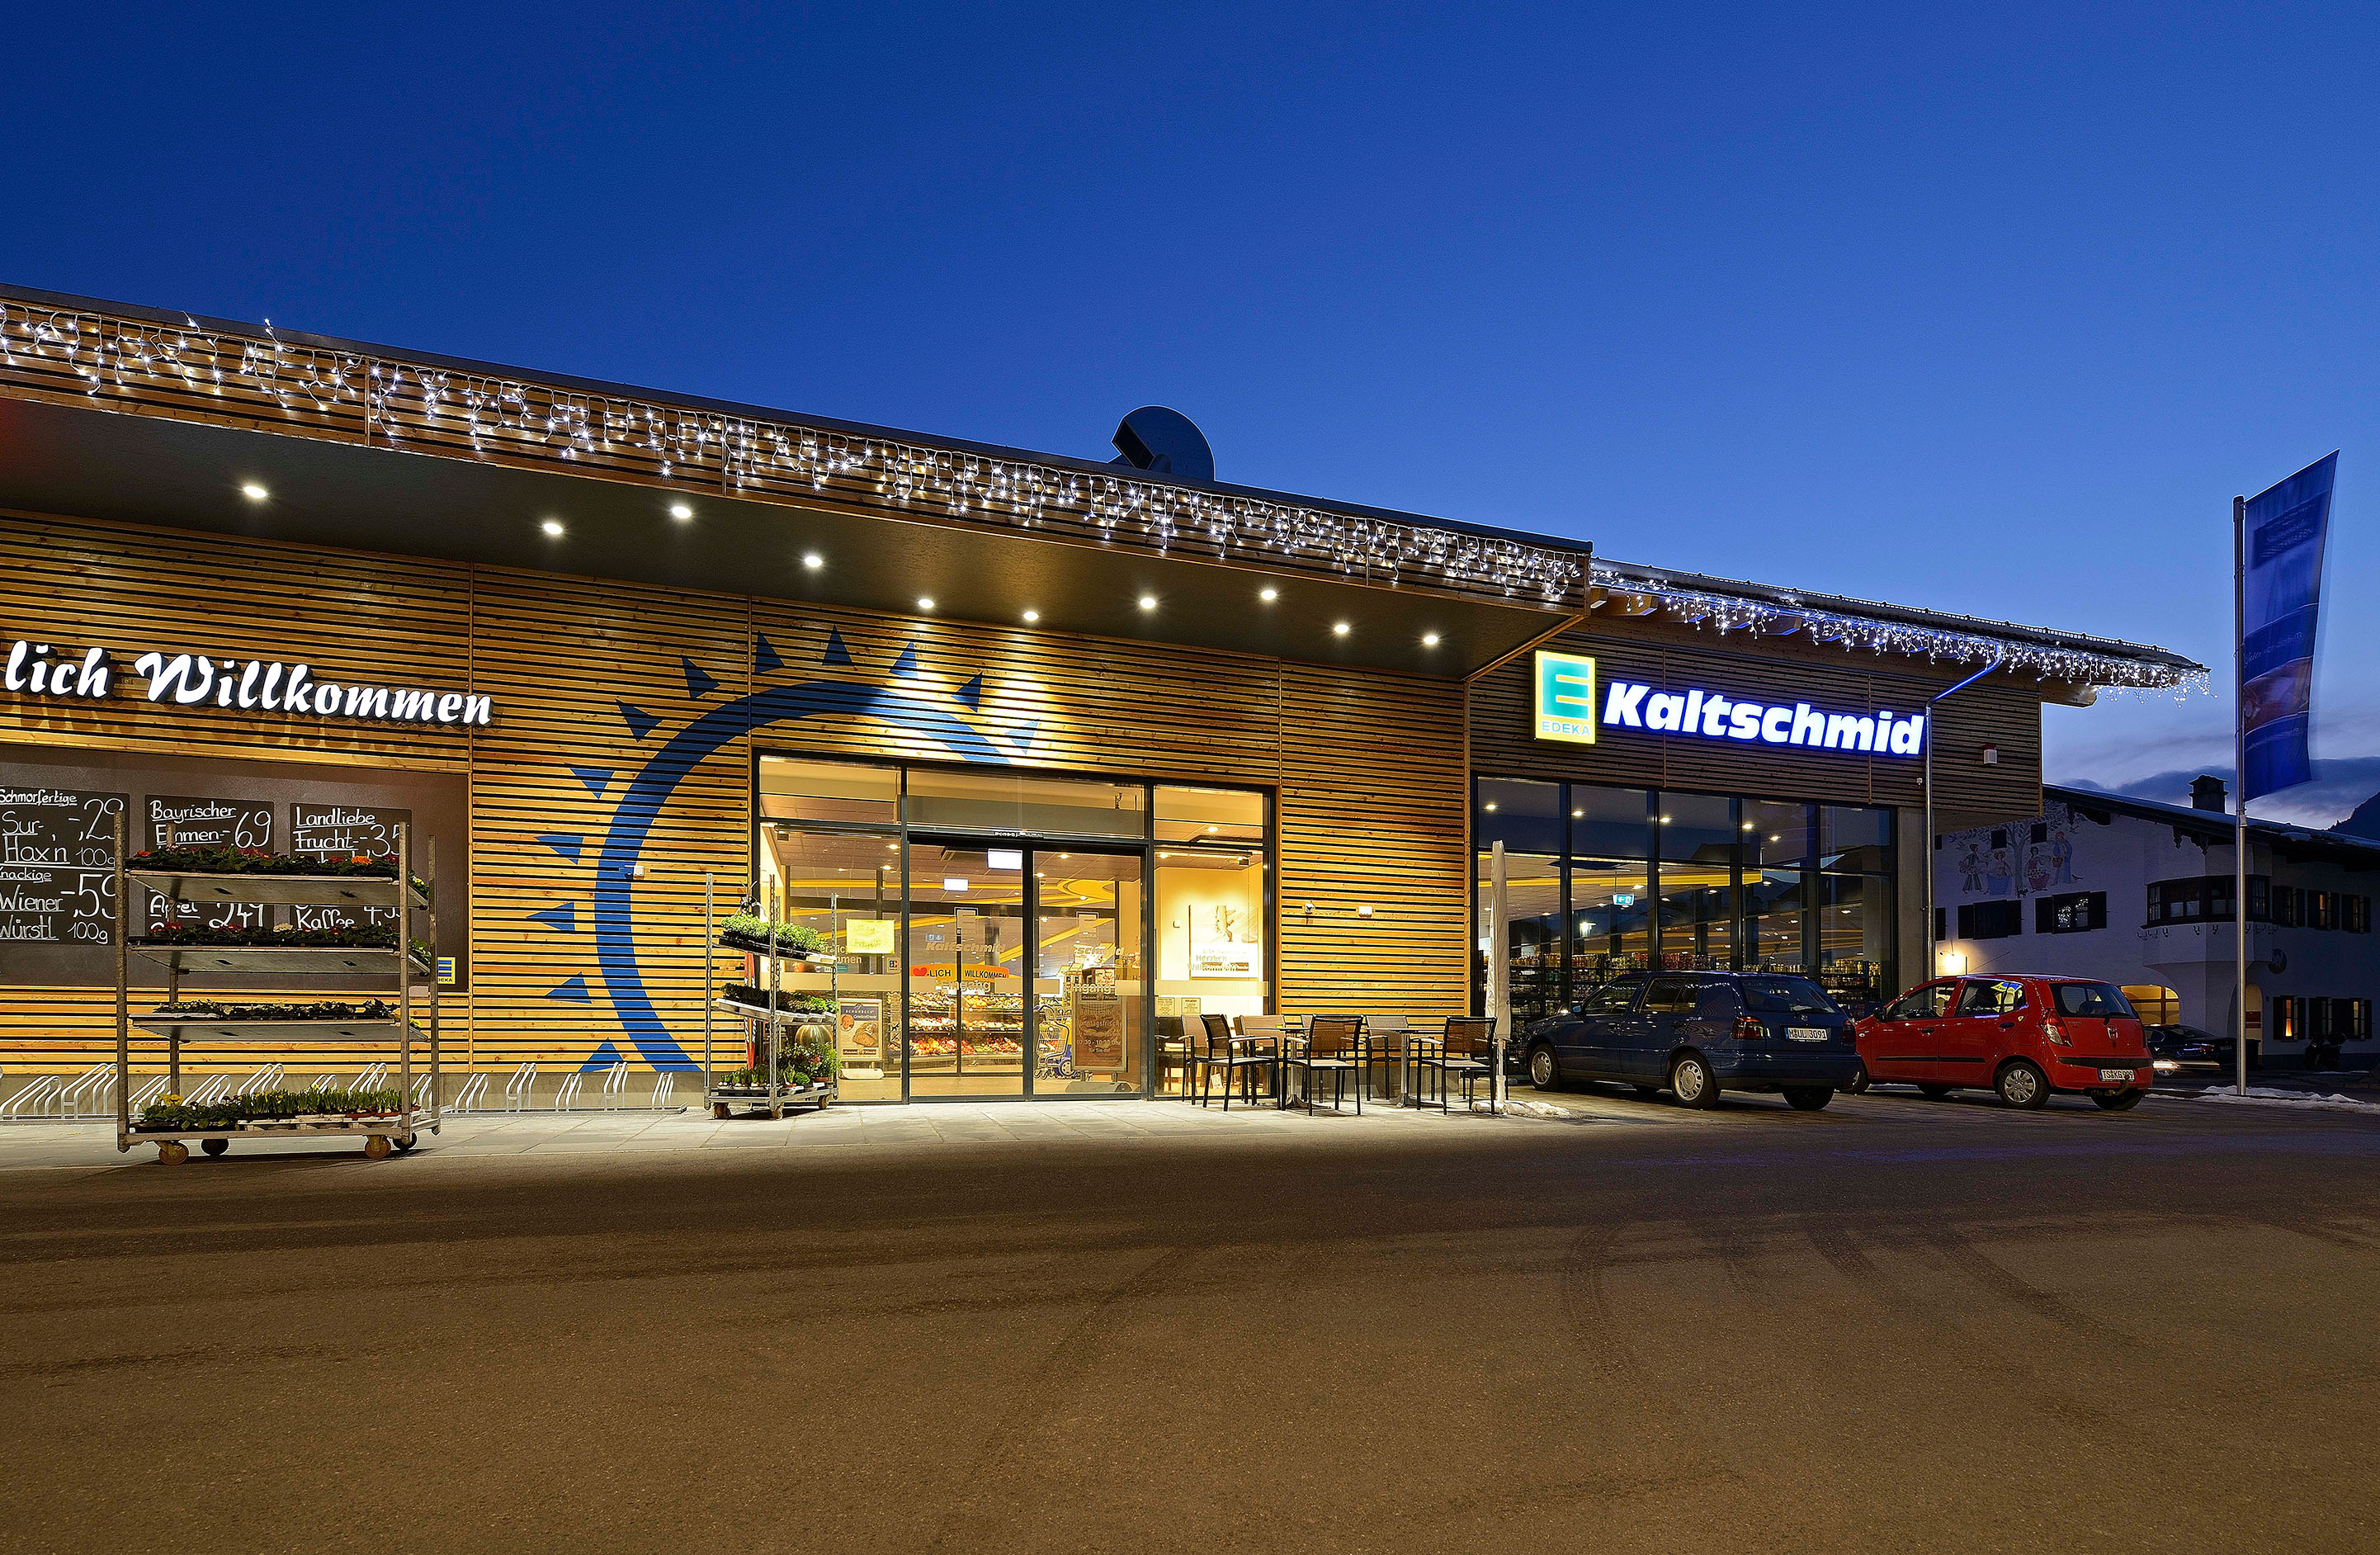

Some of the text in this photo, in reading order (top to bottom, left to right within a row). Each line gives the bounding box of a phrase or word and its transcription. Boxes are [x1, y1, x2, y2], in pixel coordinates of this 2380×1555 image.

[5, 640, 493, 726] lich Willkommen
[1542, 721, 1591, 738] EDEKA
[1603, 682, 1924, 755] Kaltschmid
[0, 789, 78, 806] Schmorfertige
[2, 811, 44, 834] Sur-
[150, 800, 237, 823] Bayrischer
[296, 806, 375, 825] Landliebe
[293, 828, 358, 849] Frucht-
[0, 885, 64, 910] Wiener
[0, 915, 108, 944] Würstl 100g
[964, 970, 1007, 979] WILLKOMMEN
